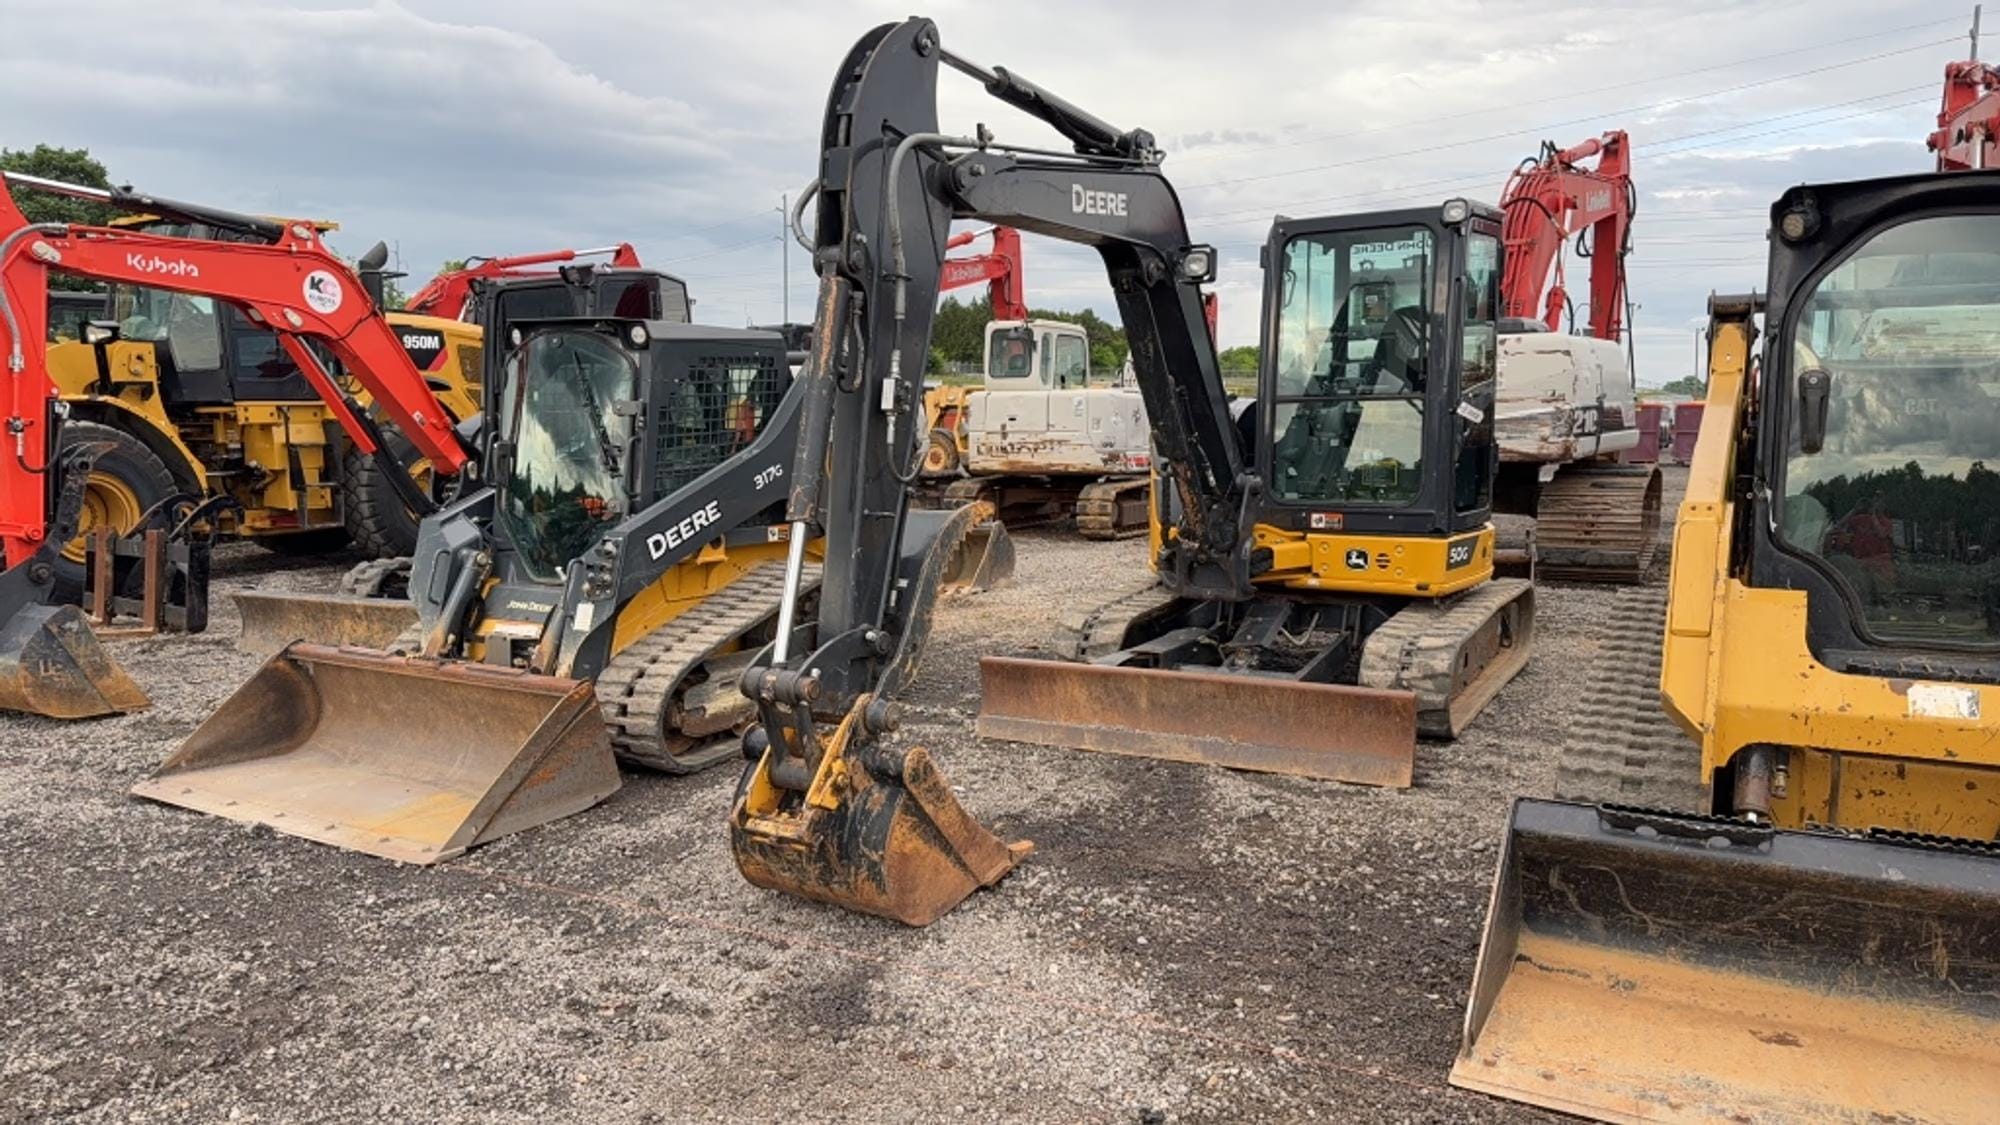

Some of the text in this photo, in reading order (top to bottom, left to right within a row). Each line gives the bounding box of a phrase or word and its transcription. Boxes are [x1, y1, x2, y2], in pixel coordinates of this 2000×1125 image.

[1072, 183, 1128, 217] DEERE
[126, 252, 200, 277] Kubota
[402, 334, 440, 350] 950M
[753, 464, 784, 491] 317G
[645, 500, 722, 560] DEERE
[1449, 545, 1469, 564] 50G
